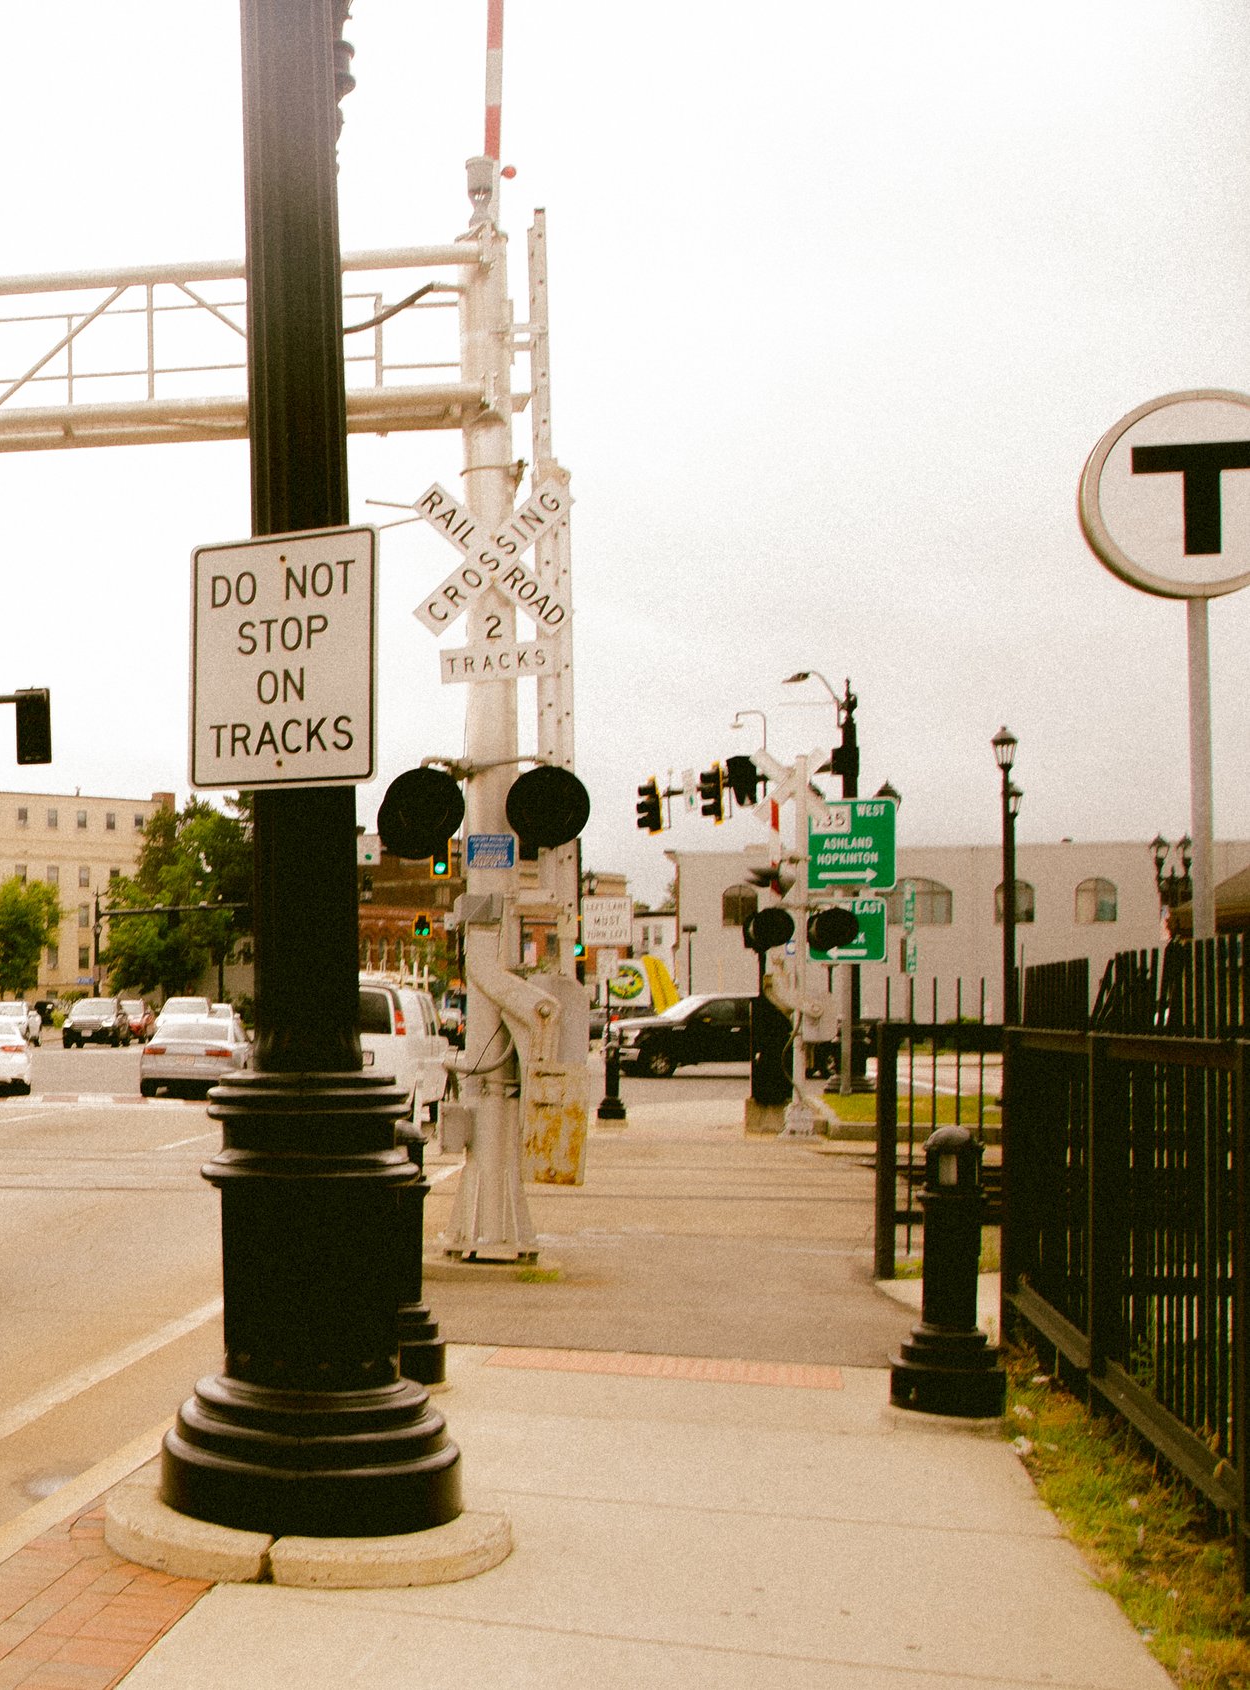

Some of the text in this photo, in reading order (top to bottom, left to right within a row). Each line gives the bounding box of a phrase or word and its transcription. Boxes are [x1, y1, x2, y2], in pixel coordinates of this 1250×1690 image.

[1131, 440, 1250, 555] T
[421, 490, 475, 550] RAIL
[428, 493, 560, 621] CROSSING
[211, 559, 356, 609] DO NOT
[503, 566, 565, 626] ROAD
[238, 614, 328, 655] STOP
[485, 615, 502, 639] 2
[446, 650, 546, 675] TRACKS
[257, 667, 305, 704] ON
[209, 715, 354, 758] TRACKS
[856, 803, 885, 817] WEST
[817, 851, 879, 866] HOPKINTON
[823, 836, 873, 850] ASHLAND
[594, 916, 620, 926] MUST
[855, 901, 882, 915] EAST
